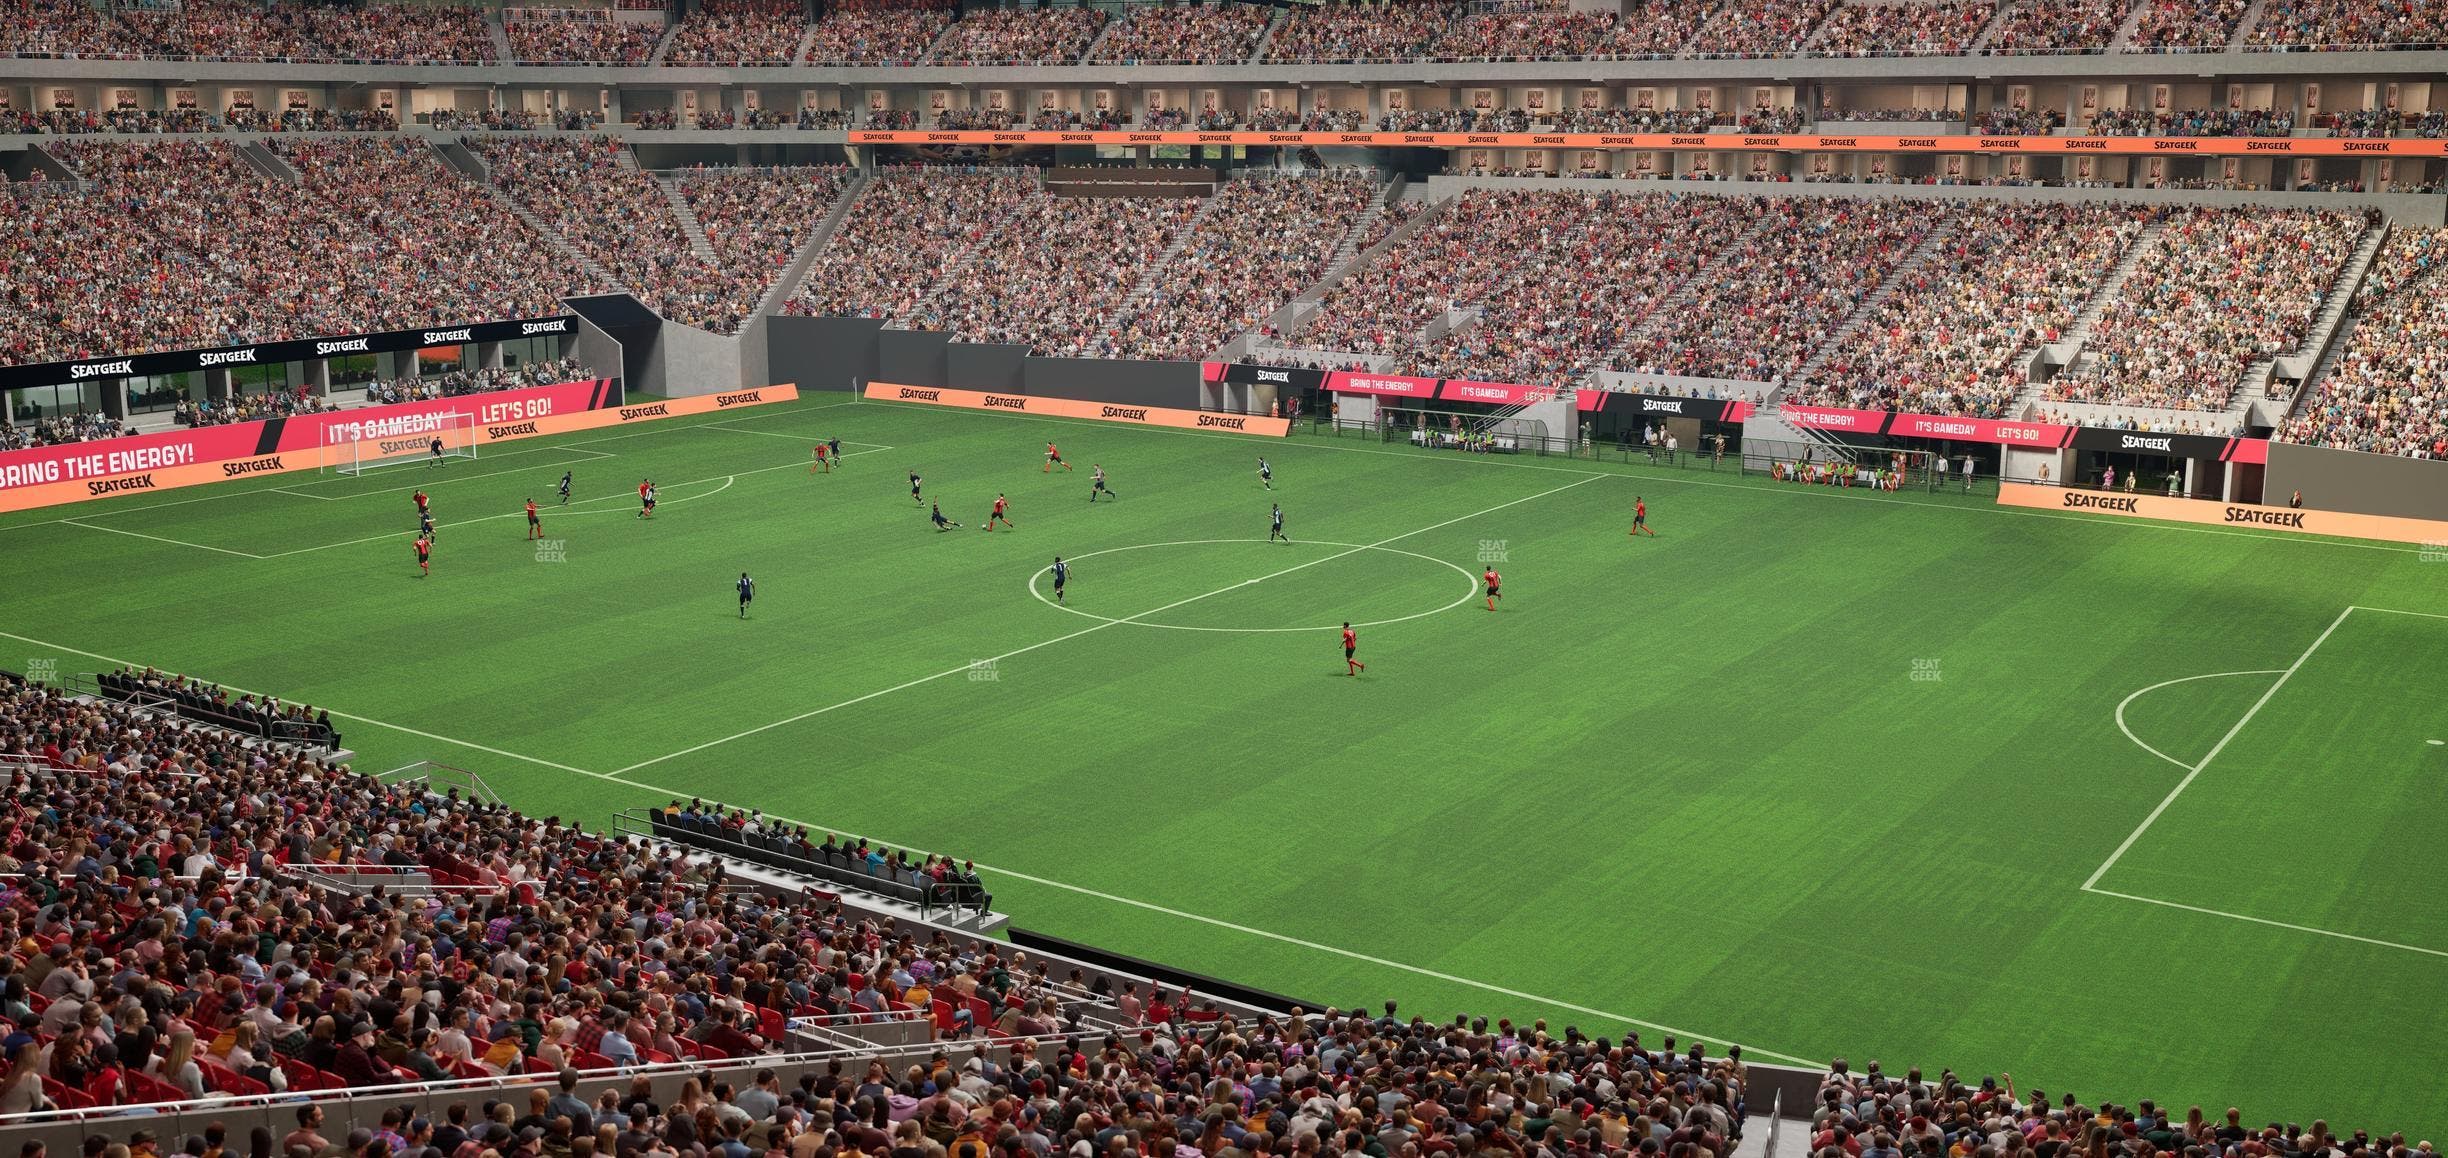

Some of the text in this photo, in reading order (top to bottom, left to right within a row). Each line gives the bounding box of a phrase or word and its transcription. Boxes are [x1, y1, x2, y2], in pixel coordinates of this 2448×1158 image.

[863, 133, 895, 141] SEATGEEK
[927, 133, 960, 141] SEATGEEK
[993, 133, 1026, 141] SEATGEEK
[1060, 134, 1094, 142] SEATGEEK
[1128, 134, 1162, 142] SEATGEEK
[1198, 134, 1232, 142] SEATGEEK
[1269, 135, 1303, 143] SEATGEEK
[1340, 135, 1373, 143] SEATGEEK
[1404, 136, 1435, 144] SEATGEEK
[1467, 136, 1499, 144] SEATGEEK
[1534, 136, 1565, 144] SEATGEEK
[1600, 137, 1634, 145] SEATGEEK
[1672, 137, 1705, 145] SEATGEEK
[1744, 138, 1780, 146] SEATGEEK
[1819, 139, 1857, 147] SEATGEEK
[1899, 139, 1936, 147] SEATGEEK
[1981, 140, 2020, 148] SEATGEEK
[2066, 140, 2106, 149] SEATGEEK
[2154, 141, 2197, 149] SEATGEEK
[2247, 142, 2291, 150] SEATGEEK
[2343, 142, 2389, 151] SEATGEEK
[522, 319, 566, 335] SEATGEEK
[424, 328, 471, 344] SEATGEEK
[316, 338, 368, 355] SEATGEEK
[200, 349, 256, 367] SEATGEEK
[71, 360, 133, 379] SEATGEEK
[1258, 370, 1288, 384] SEATGEEK
[1350, 378, 1414, 392] BRING THE ENERGY!
[717, 390, 762, 408] SEATGEEK
[899, 388, 940, 402] SEATGEEK
[1461, 386, 1509, 400] IT'S GAMEDAY
[984, 394, 1027, 410] SEATGEEK
[1642, 399, 1682, 414] SEATGEEK
[482, 397, 552, 423] LET'S GO!
[620, 404, 669, 422] SEATGEEK
[1101, 406, 1147, 422] SEATGEEK
[1196, 414, 1246, 430] SEATGEEK
[1802, 412, 1818, 423] THE
[1819, 414, 1854, 426] ENERGY!
[329, 411, 444, 444] IT'S GAMEDAY
[488, 421, 538, 440] SEATGEEK
[1916, 421, 1976, 436] IT'S GAMEDAY
[1996, 427, 2040, 441] LET'S GO!
[2121, 435, 2171, 452] SEATGEEK
[64, 454, 105, 478] THE
[108, 442, 194, 473] ENERGY!
[222, 456, 284, 478] SEATGEEK
[88, 474, 156, 497] SEATGEEK
[2063, 492, 2139, 514] SEATGEEK
[2224, 506, 2306, 530] SEATGEEK
